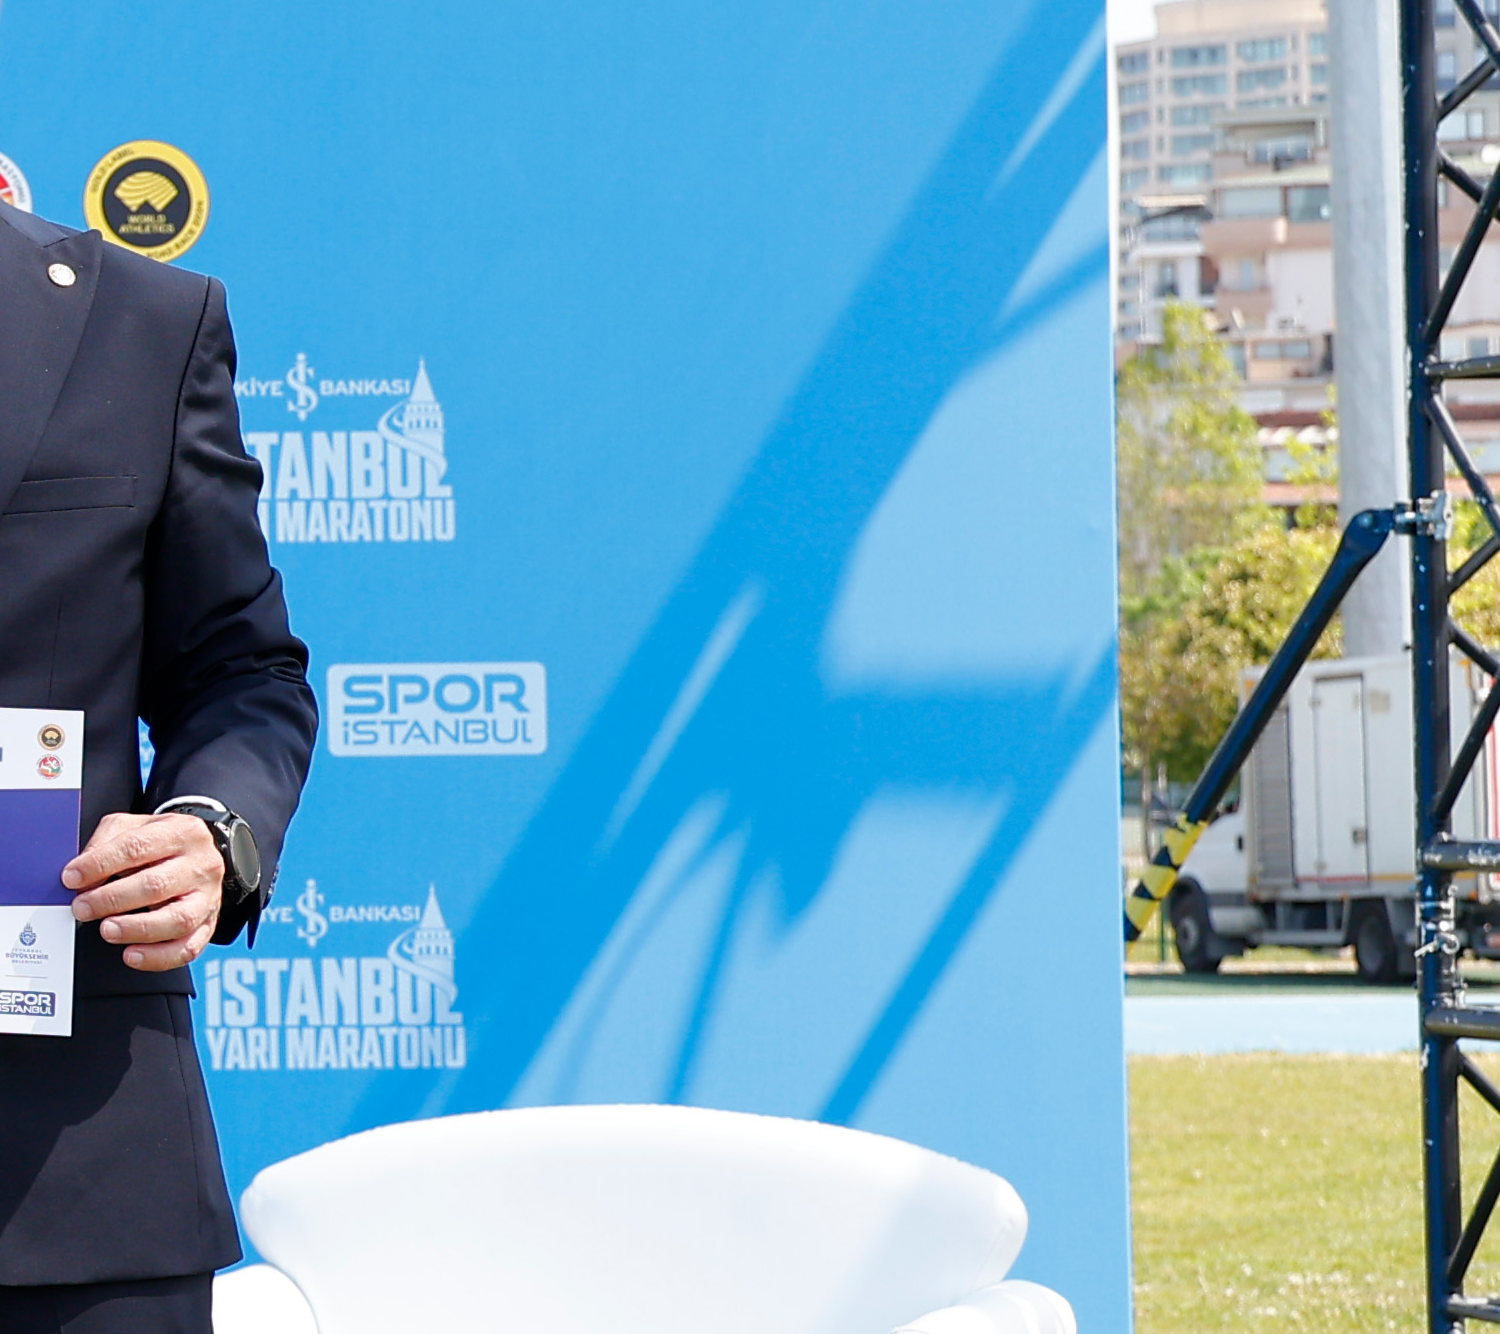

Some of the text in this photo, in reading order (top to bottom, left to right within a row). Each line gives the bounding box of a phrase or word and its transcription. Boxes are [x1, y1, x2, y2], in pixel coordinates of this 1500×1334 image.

[235, 377, 284, 396] KİYE
[319, 379, 410, 395] BANKASI
[245, 431, 452, 500] TANBUL
[276, 500, 455, 543] MARATONU
[342, 673, 529, 715] SPOR
[329, 906, 420, 922] BANKASI
[0, 992, 52, 1006] SPOR
[205, 1026, 466, 1070] YARI MARATONU
